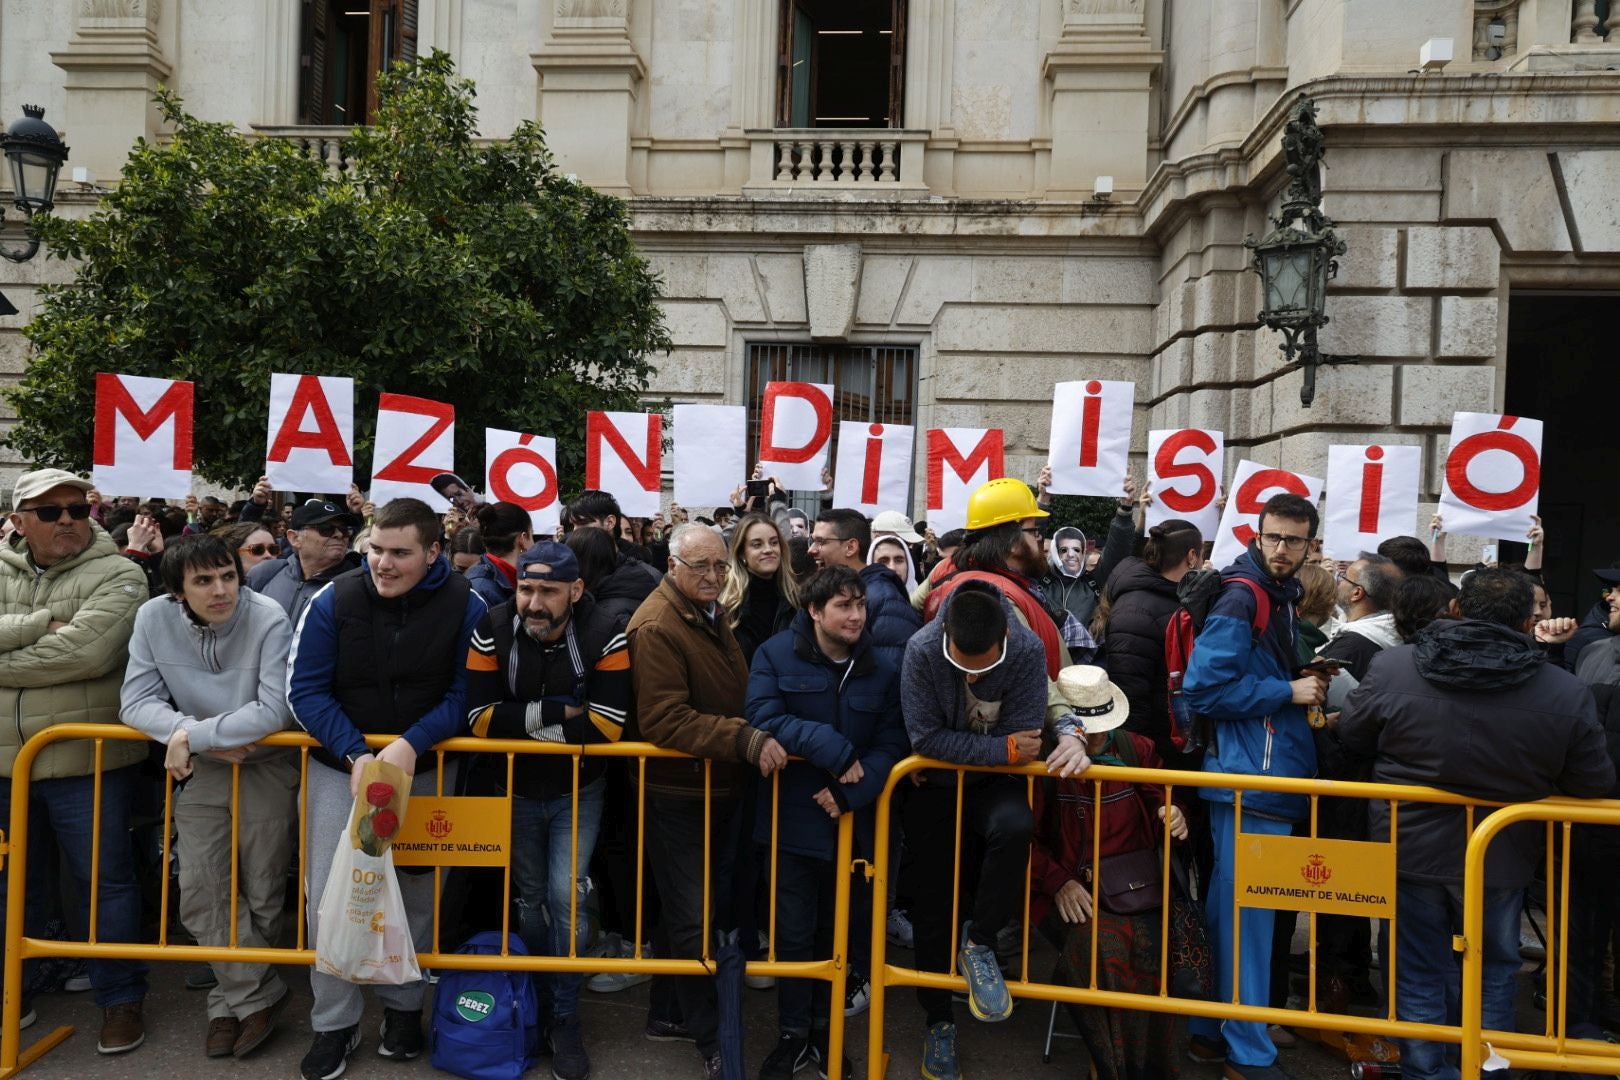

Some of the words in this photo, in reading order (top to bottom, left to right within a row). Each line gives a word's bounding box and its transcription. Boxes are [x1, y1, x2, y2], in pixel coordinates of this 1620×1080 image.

[441, 843, 454, 852] DE
[1246, 885, 1316, 899] AJUNTAMENT
[1318, 890, 1333, 900] DE
